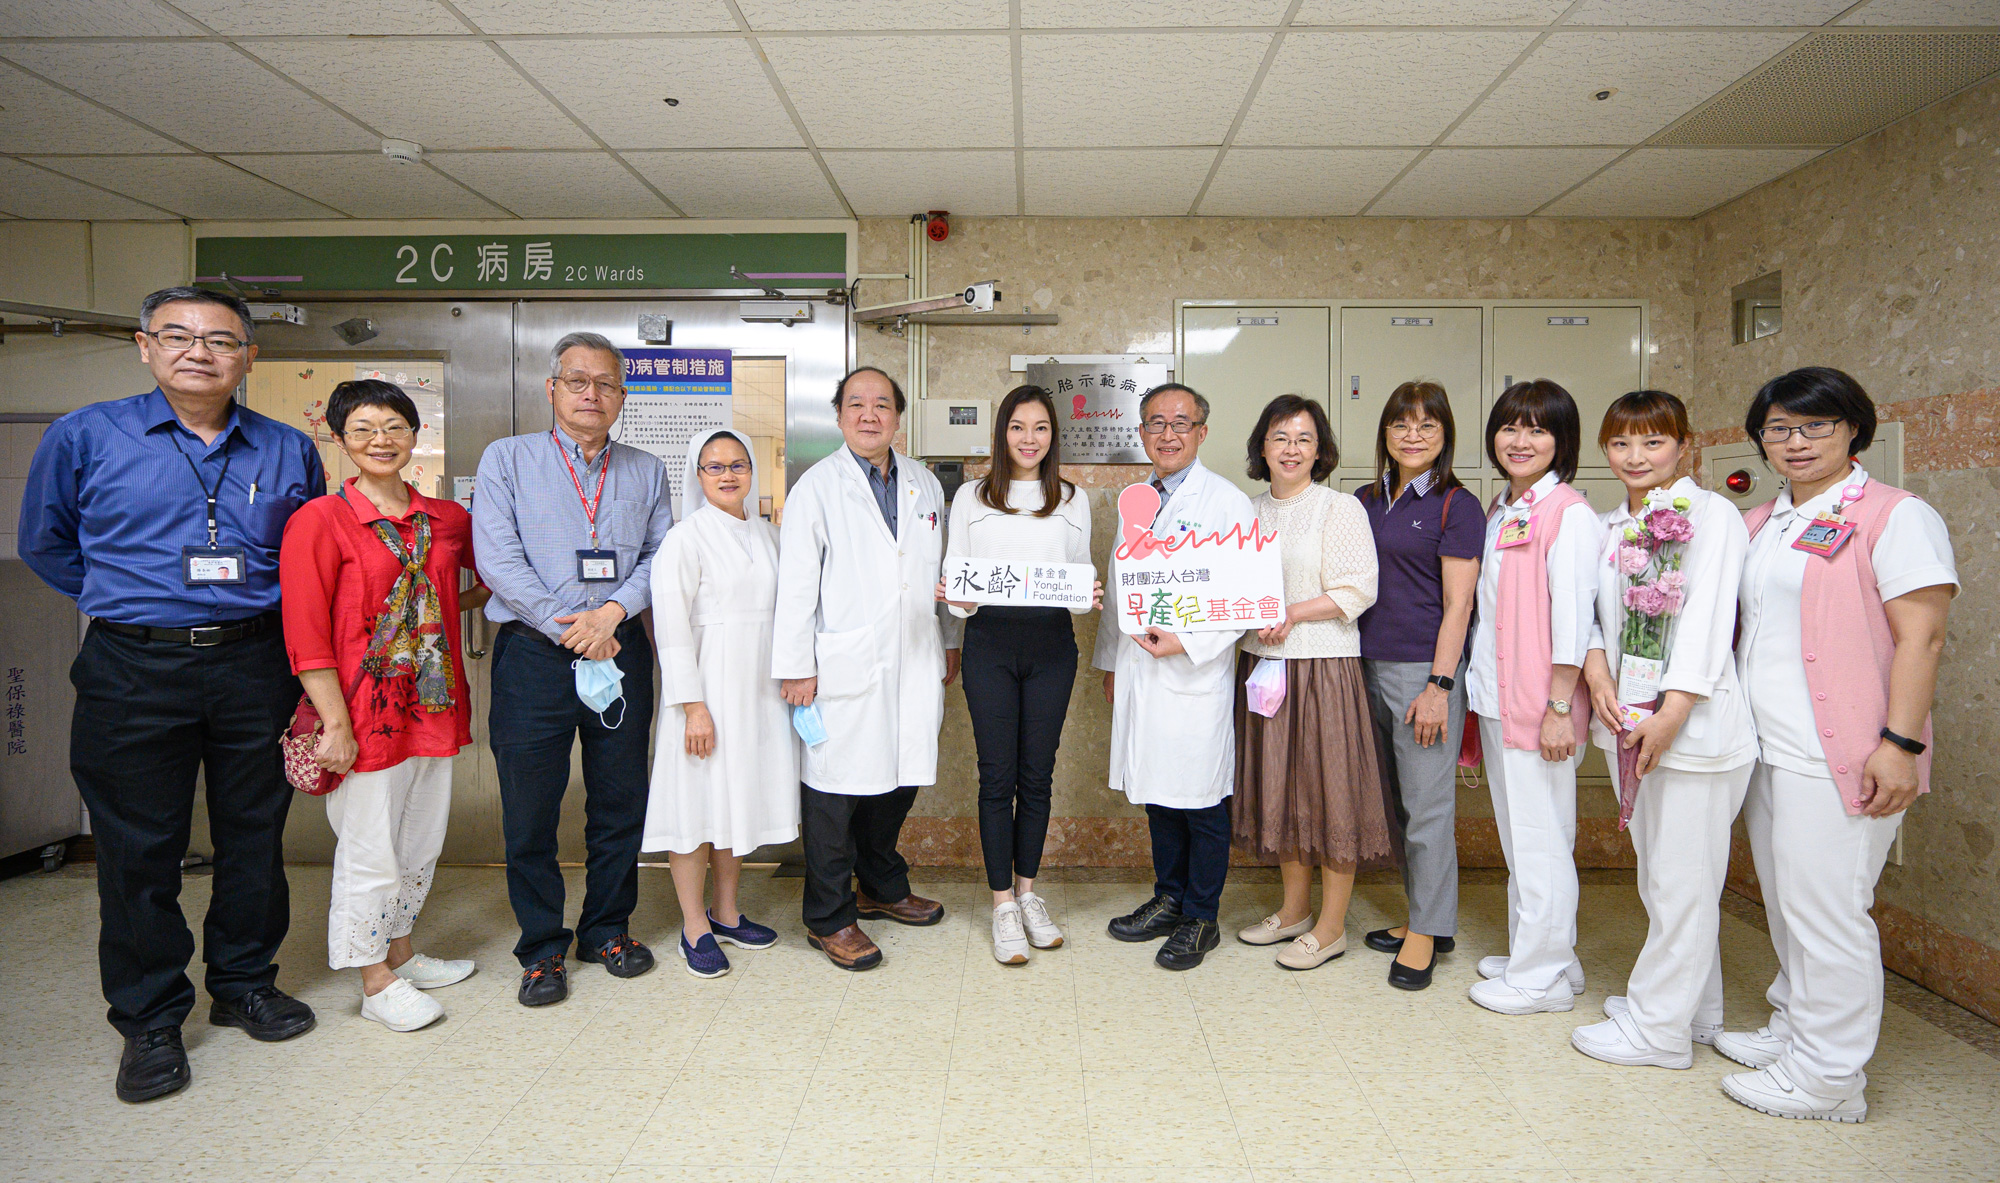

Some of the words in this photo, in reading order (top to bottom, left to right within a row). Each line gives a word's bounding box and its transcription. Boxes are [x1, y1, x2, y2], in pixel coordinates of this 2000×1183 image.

[395, 243, 454, 284] 2C
[476, 241, 555, 283] 病房
[564, 264, 588, 282] 2C
[594, 264, 645, 282] Wards
[953, 562, 1021, 599] 永齡
[1034, 567, 1068, 579] 基金會
[1033, 580, 1073, 592] YongLin
[1121, 568, 1211, 586] 財團法人台灣
[1033, 591, 1088, 603] Foundation
[1126, 588, 1281, 627] 早產兒基金會
[5, 666, 27, 756] 聖保祿醫院
